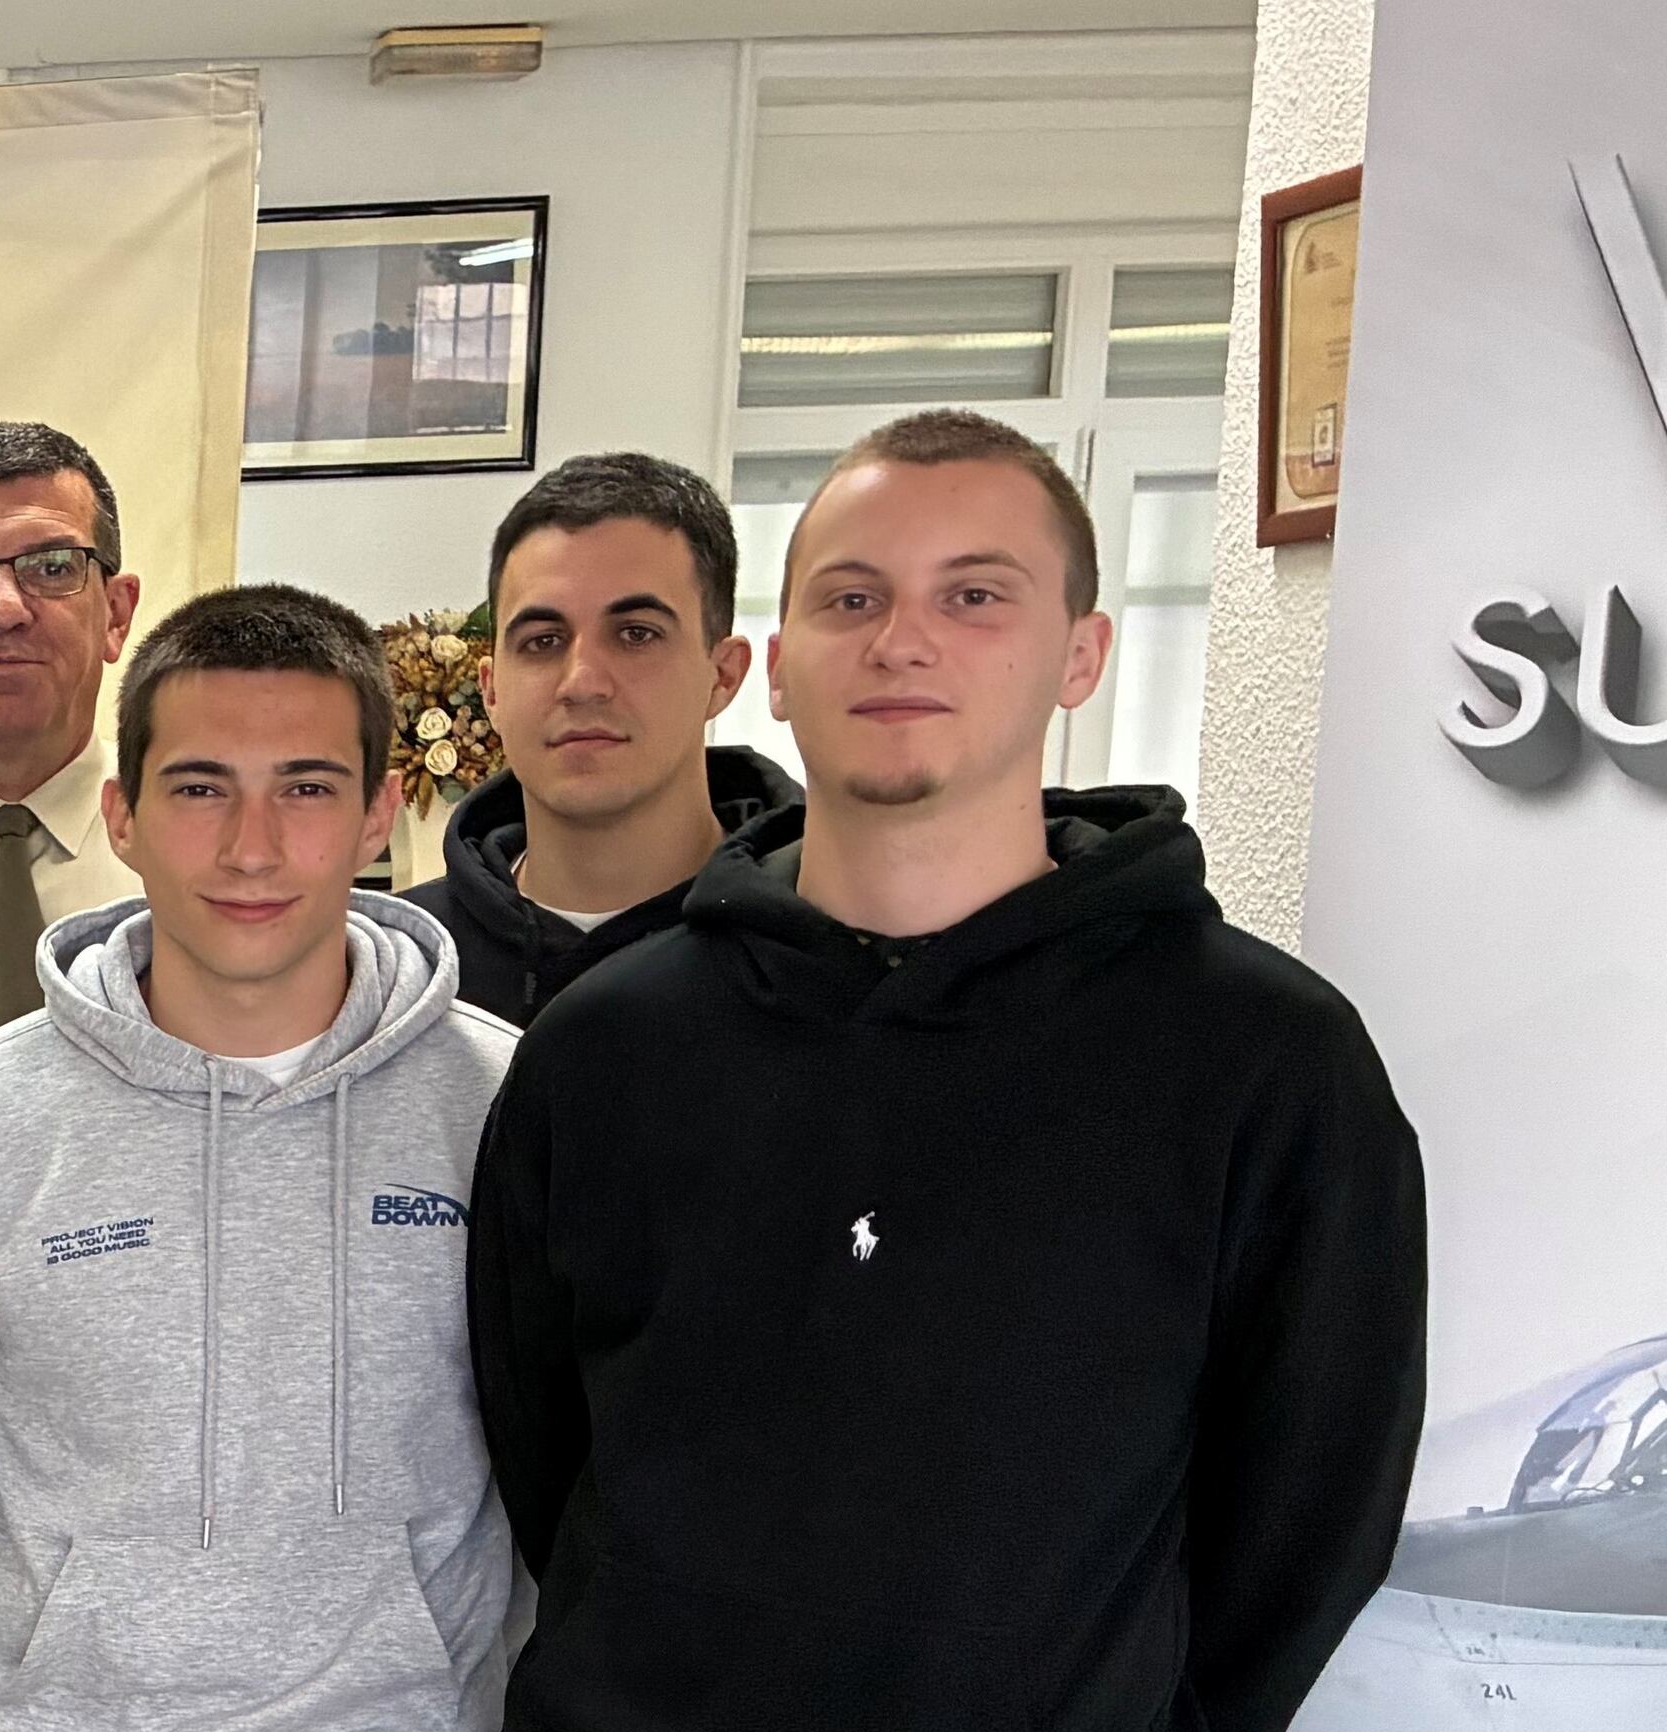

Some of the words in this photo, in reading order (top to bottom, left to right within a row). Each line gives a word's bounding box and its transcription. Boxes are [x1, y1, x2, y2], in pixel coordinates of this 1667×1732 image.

[373, 1194, 439, 1211] BEAT
[371, 1210, 460, 1226] DOWN
[41, 1226, 104, 1247] PROJECT
[107, 1217, 155, 1232] VISION
[50, 1242, 75, 1254] ALL
[78, 1235, 106, 1248] YOU
[109, 1228, 147, 1242] NEED
